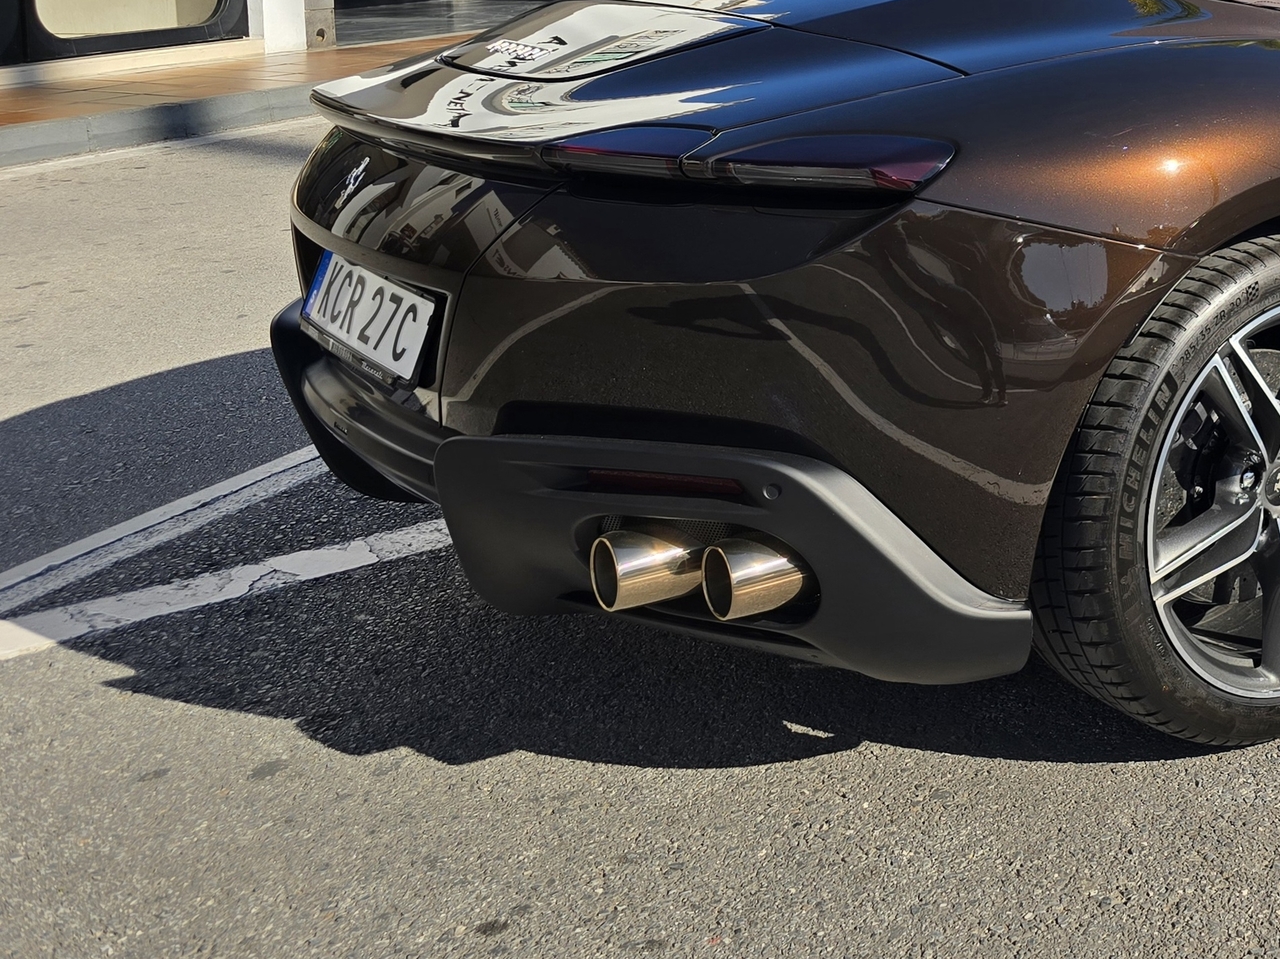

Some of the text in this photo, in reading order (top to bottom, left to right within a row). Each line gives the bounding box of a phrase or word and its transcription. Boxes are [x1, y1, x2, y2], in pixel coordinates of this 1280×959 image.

[317, 261, 367, 335] KCR
[357, 285, 418, 362] 27C
[1213, 308, 1227, 328] ZR
[1118, 382, 1172, 560] MICHELIN
